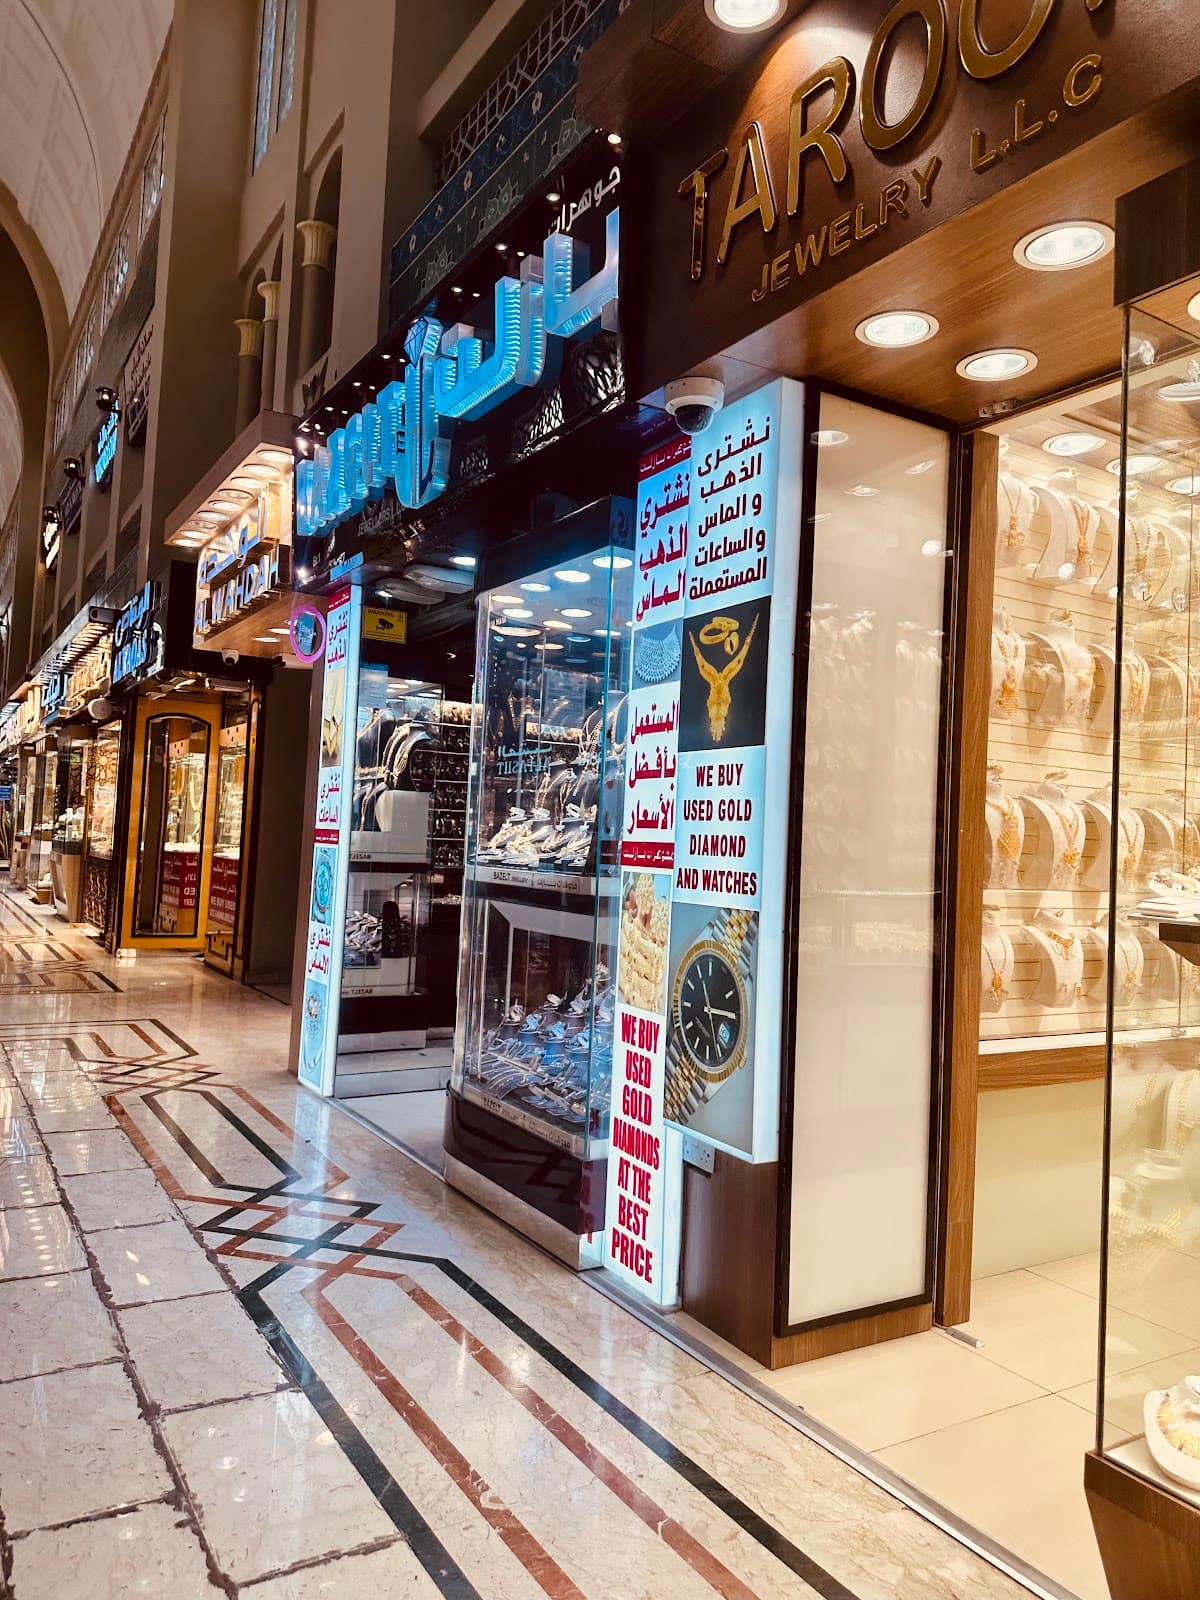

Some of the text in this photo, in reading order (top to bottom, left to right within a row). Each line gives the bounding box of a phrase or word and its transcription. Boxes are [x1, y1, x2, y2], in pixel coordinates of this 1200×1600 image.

[677, 0, 1102, 281] TAROO
[752, 157, 941, 302] JEWELRY
[700, 453, 762, 504] الذهب
[640, 473, 690, 538] نشتري
[639, 522, 688, 580] الذهب
[211, 544, 279, 625] WAHDAH
[689, 556, 768, 600] المستعملة
[367, 608, 395, 618] WARNING
[630, 701, 679, 745] المستعمل
[628, 746, 677, 790] بأفضل
[695, 763, 744, 788] WE BUY
[627, 793, 675, 835] الأسعار
[683, 799, 752, 822] USED GOLD
[689, 834, 746, 858] DIAMOND
[493, 871, 511, 881] BAZELT
[676, 868, 757, 896] AND WATCHES
[620, 1011, 637, 1046] WE
[637, 1017, 660, 1054] BUY
[625, 1049, 652, 1089] USED
[622, 1084, 652, 1127] GOLD
[612, 1116, 661, 1171] DIAMONDS
[617, 1157, 651, 1204] AT THE
[617, 1193, 649, 1241] BEST
[611, 1227, 654, 1284] PRICE
